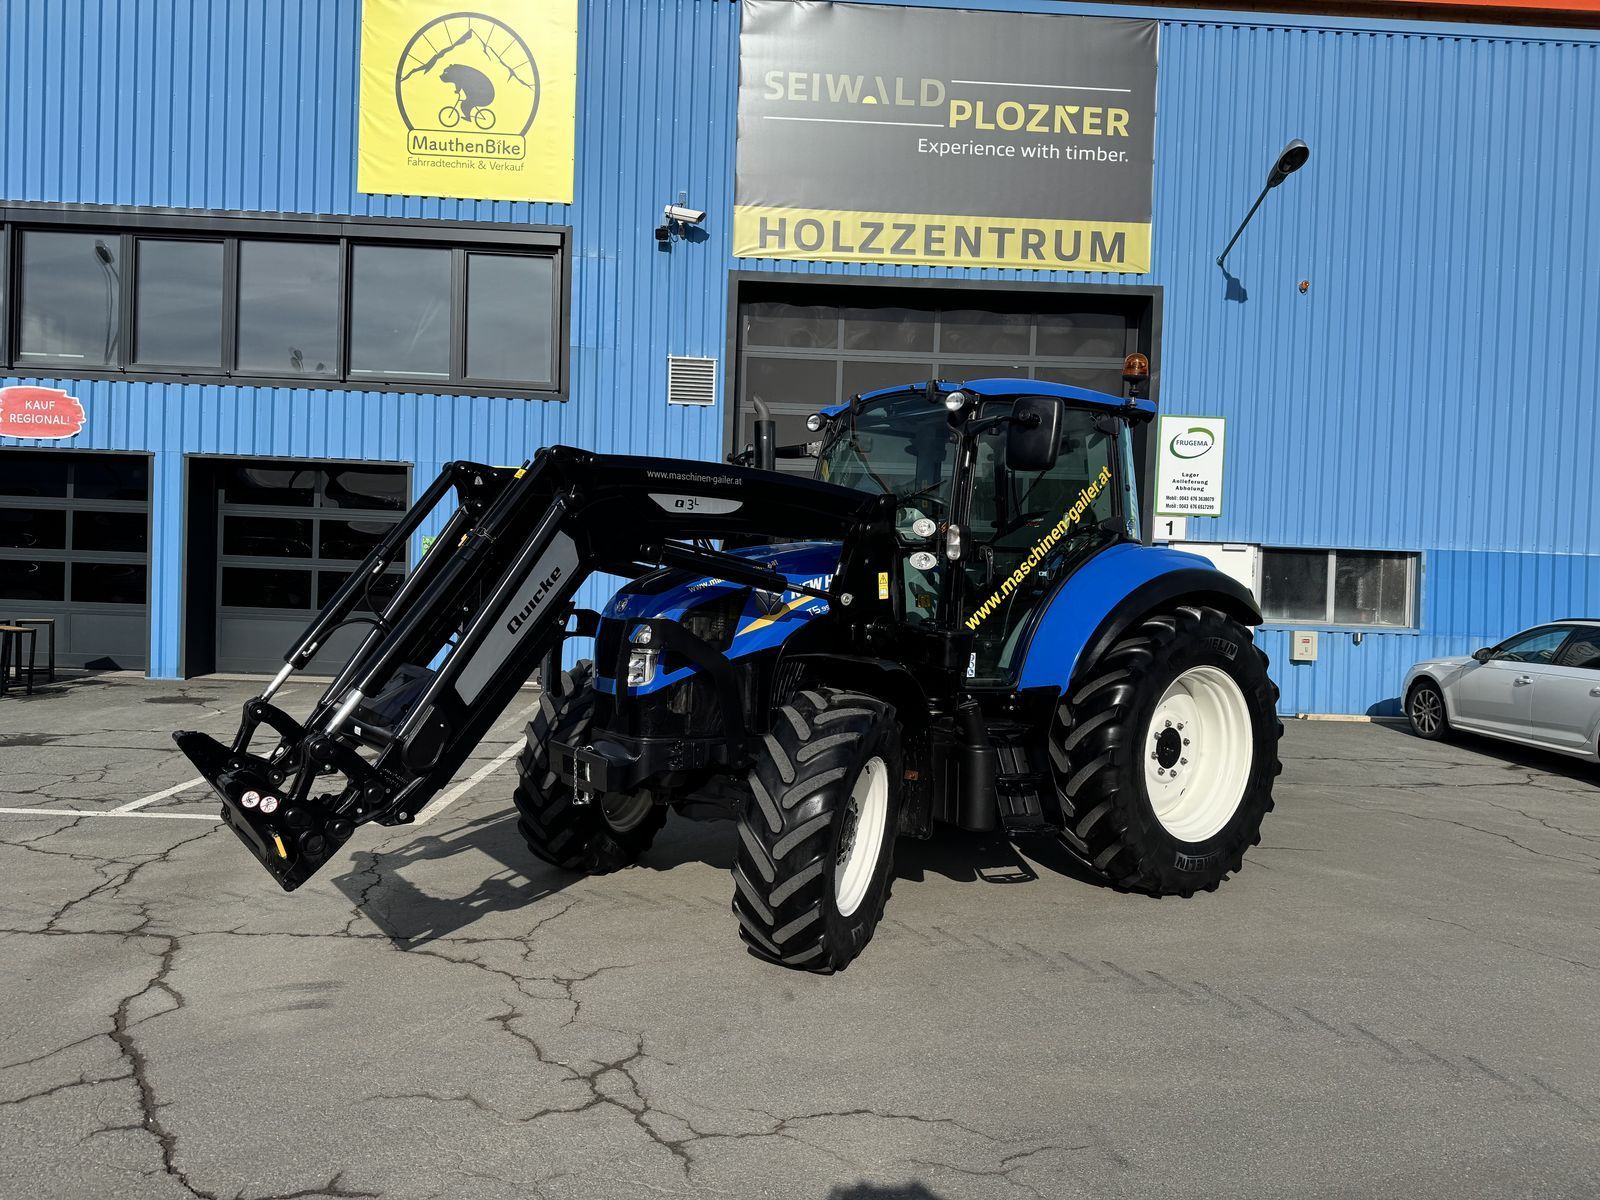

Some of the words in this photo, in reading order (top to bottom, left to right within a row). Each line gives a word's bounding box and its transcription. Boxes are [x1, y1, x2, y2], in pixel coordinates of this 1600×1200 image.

[763, 70, 946, 107] SEIWALD
[949, 99, 1130, 137] PLOZNER
[412, 135, 521, 155] MauthenBike
[917, 138, 1015, 159] Experience
[1020, 142, 1060, 161] with
[1065, 145, 1129, 163] timber.
[407, 156, 475, 169] Fahrradtechnik
[478, 160, 486, 170] &
[489, 161, 525, 172] Verkauf
[758, 216, 1126, 264] HOLZZENTRUM
[25, 400, 56, 411] KAUF
[9, 413, 70, 425] REGIONAL!
[646, 470, 742, 486] www.maschinen-gailer.at
[1165, 520, 1174, 536] 1
[964, 465, 1113, 631] www.maschinen-gailer.at
[506, 566, 562, 635] Quicke
